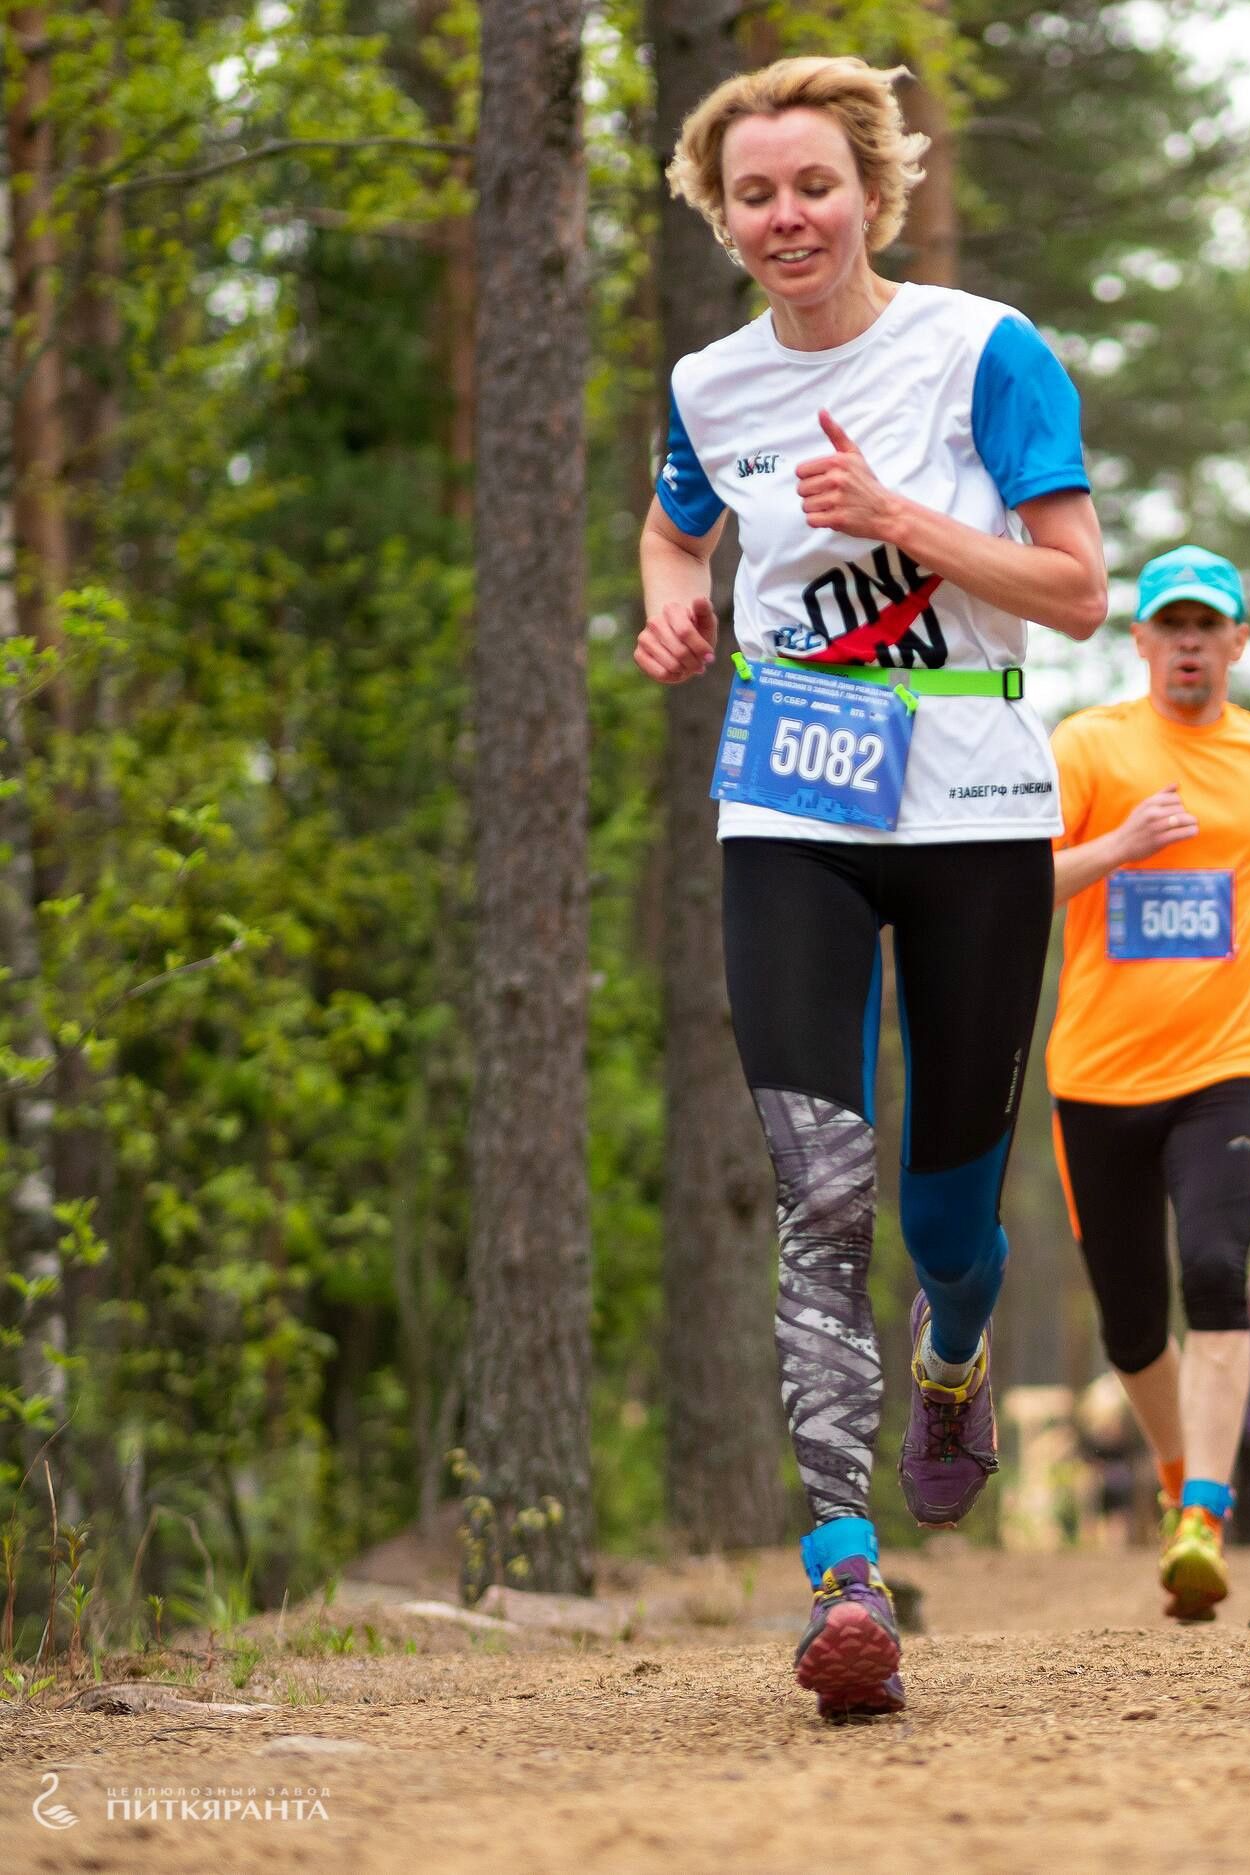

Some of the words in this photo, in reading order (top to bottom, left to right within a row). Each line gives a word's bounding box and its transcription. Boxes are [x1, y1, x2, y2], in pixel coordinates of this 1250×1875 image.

[783, 695, 808, 706] СБЕР
[769, 716, 884, 793] 5082
[949, 785, 1007, 798] #ЗАБЕГРФ
[1142, 899, 1220, 938] 5055
